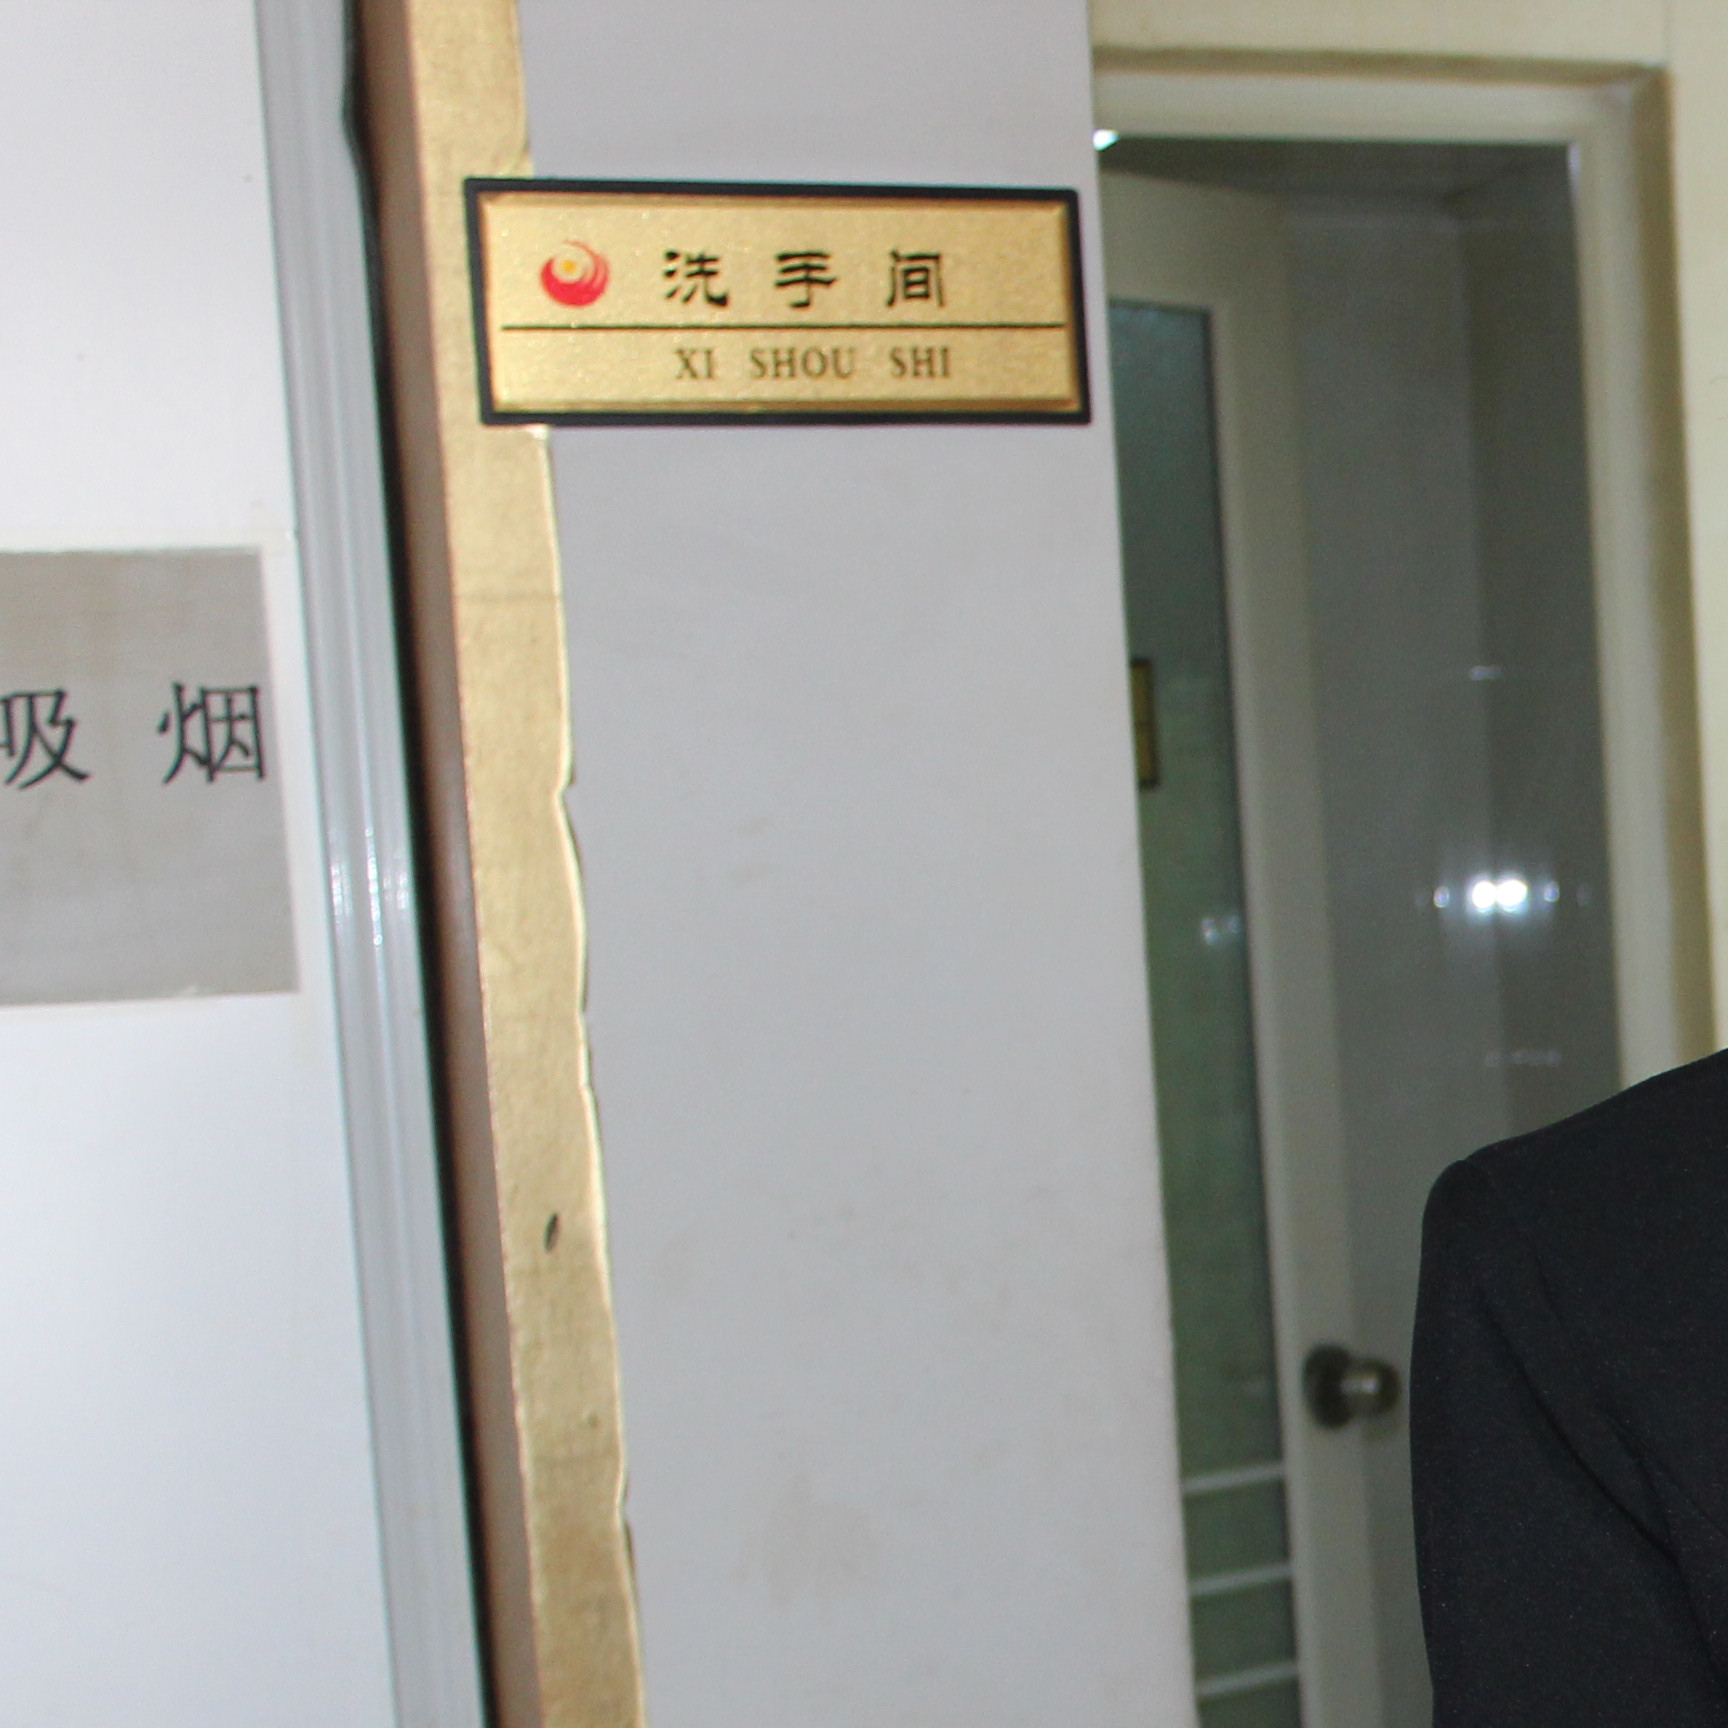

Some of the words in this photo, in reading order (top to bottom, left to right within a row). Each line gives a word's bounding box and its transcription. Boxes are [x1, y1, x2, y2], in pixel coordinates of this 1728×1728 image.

[661, 249, 947, 310] 洗手间
[674, 347, 717, 381] XI
[749, 346, 856, 380] SHOU
[889, 345, 952, 380] SHI
[0, 681, 266, 790] 吸烟
